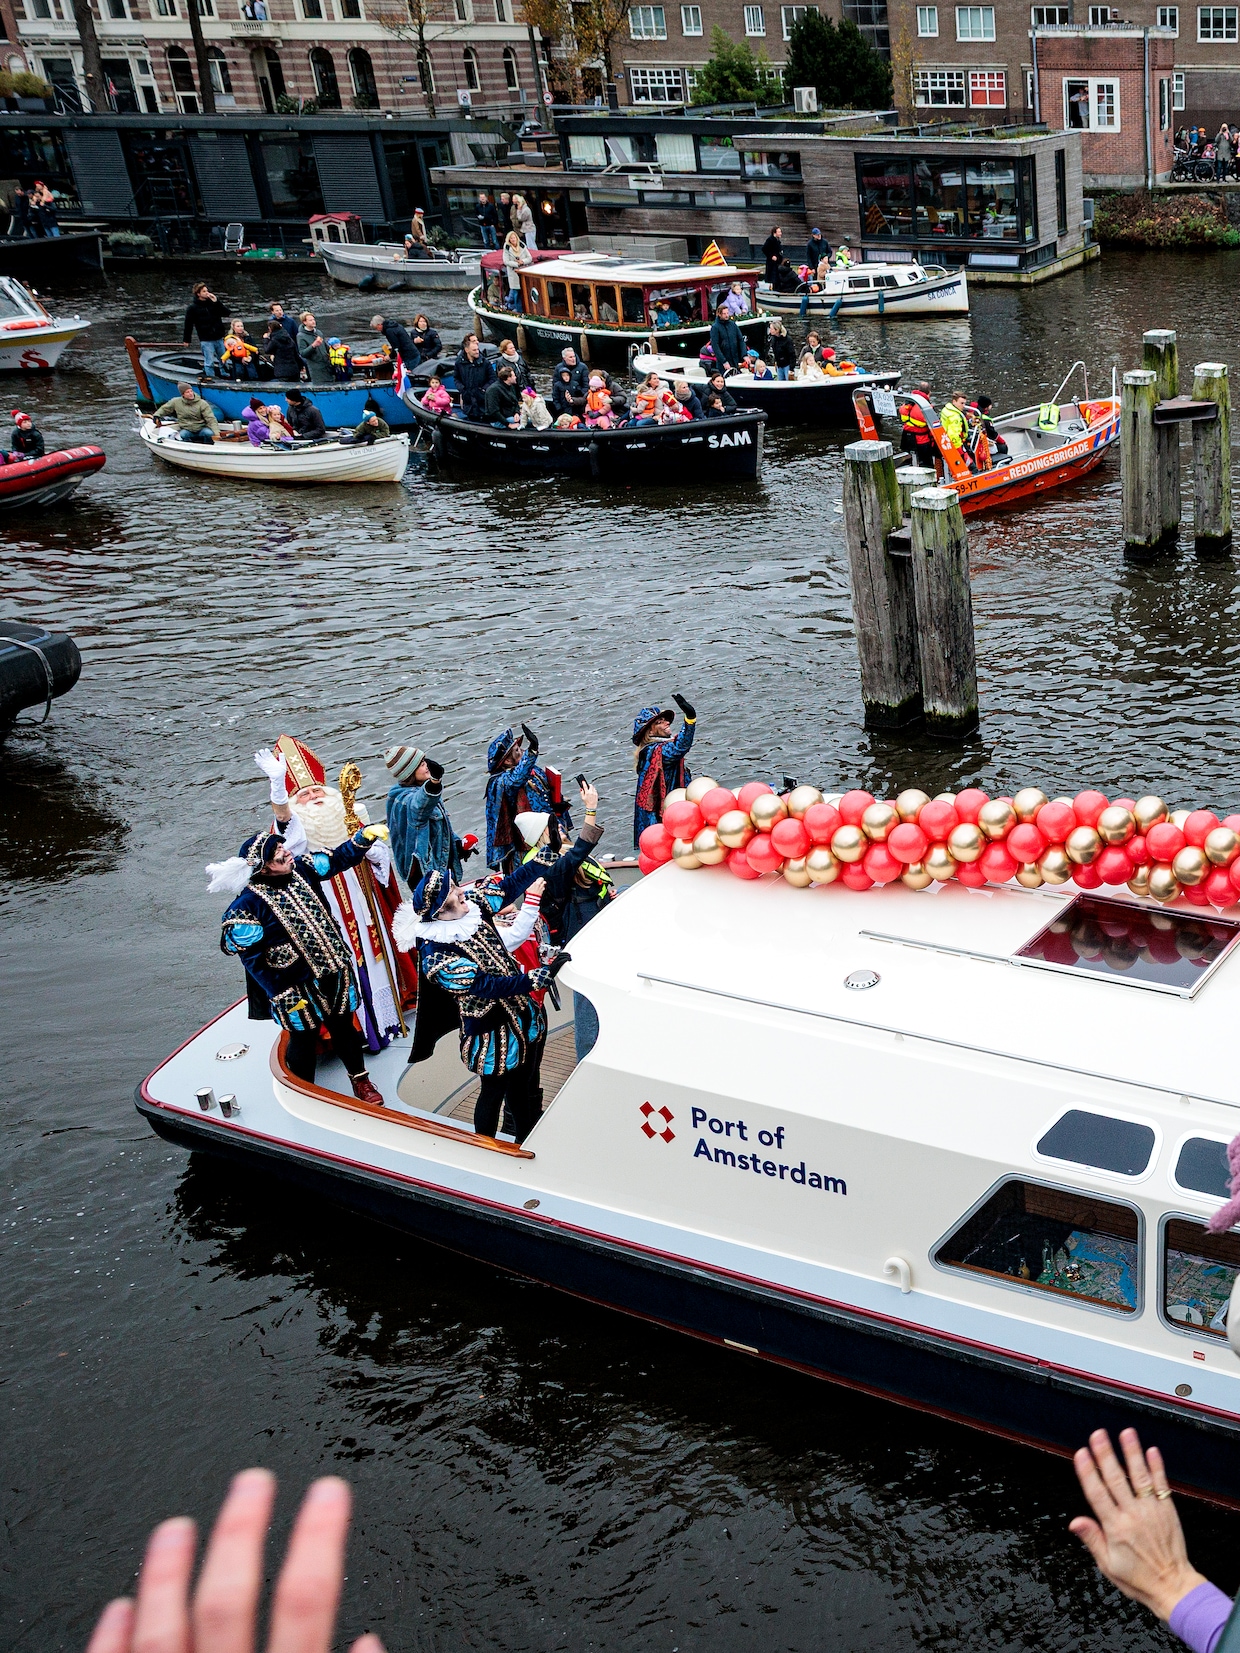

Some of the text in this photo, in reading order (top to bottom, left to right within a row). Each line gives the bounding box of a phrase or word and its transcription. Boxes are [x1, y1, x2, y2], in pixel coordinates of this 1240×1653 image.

[928, 291, 936, 301] SA
[876, 400, 892, 408] Team
[707, 430, 752, 449] SAM
[1009, 440, 1090, 479] REDDINGSBRIGADE
[691, 1105, 785, 1150] Port of
[693, 1137, 848, 1196] Amsterdam
